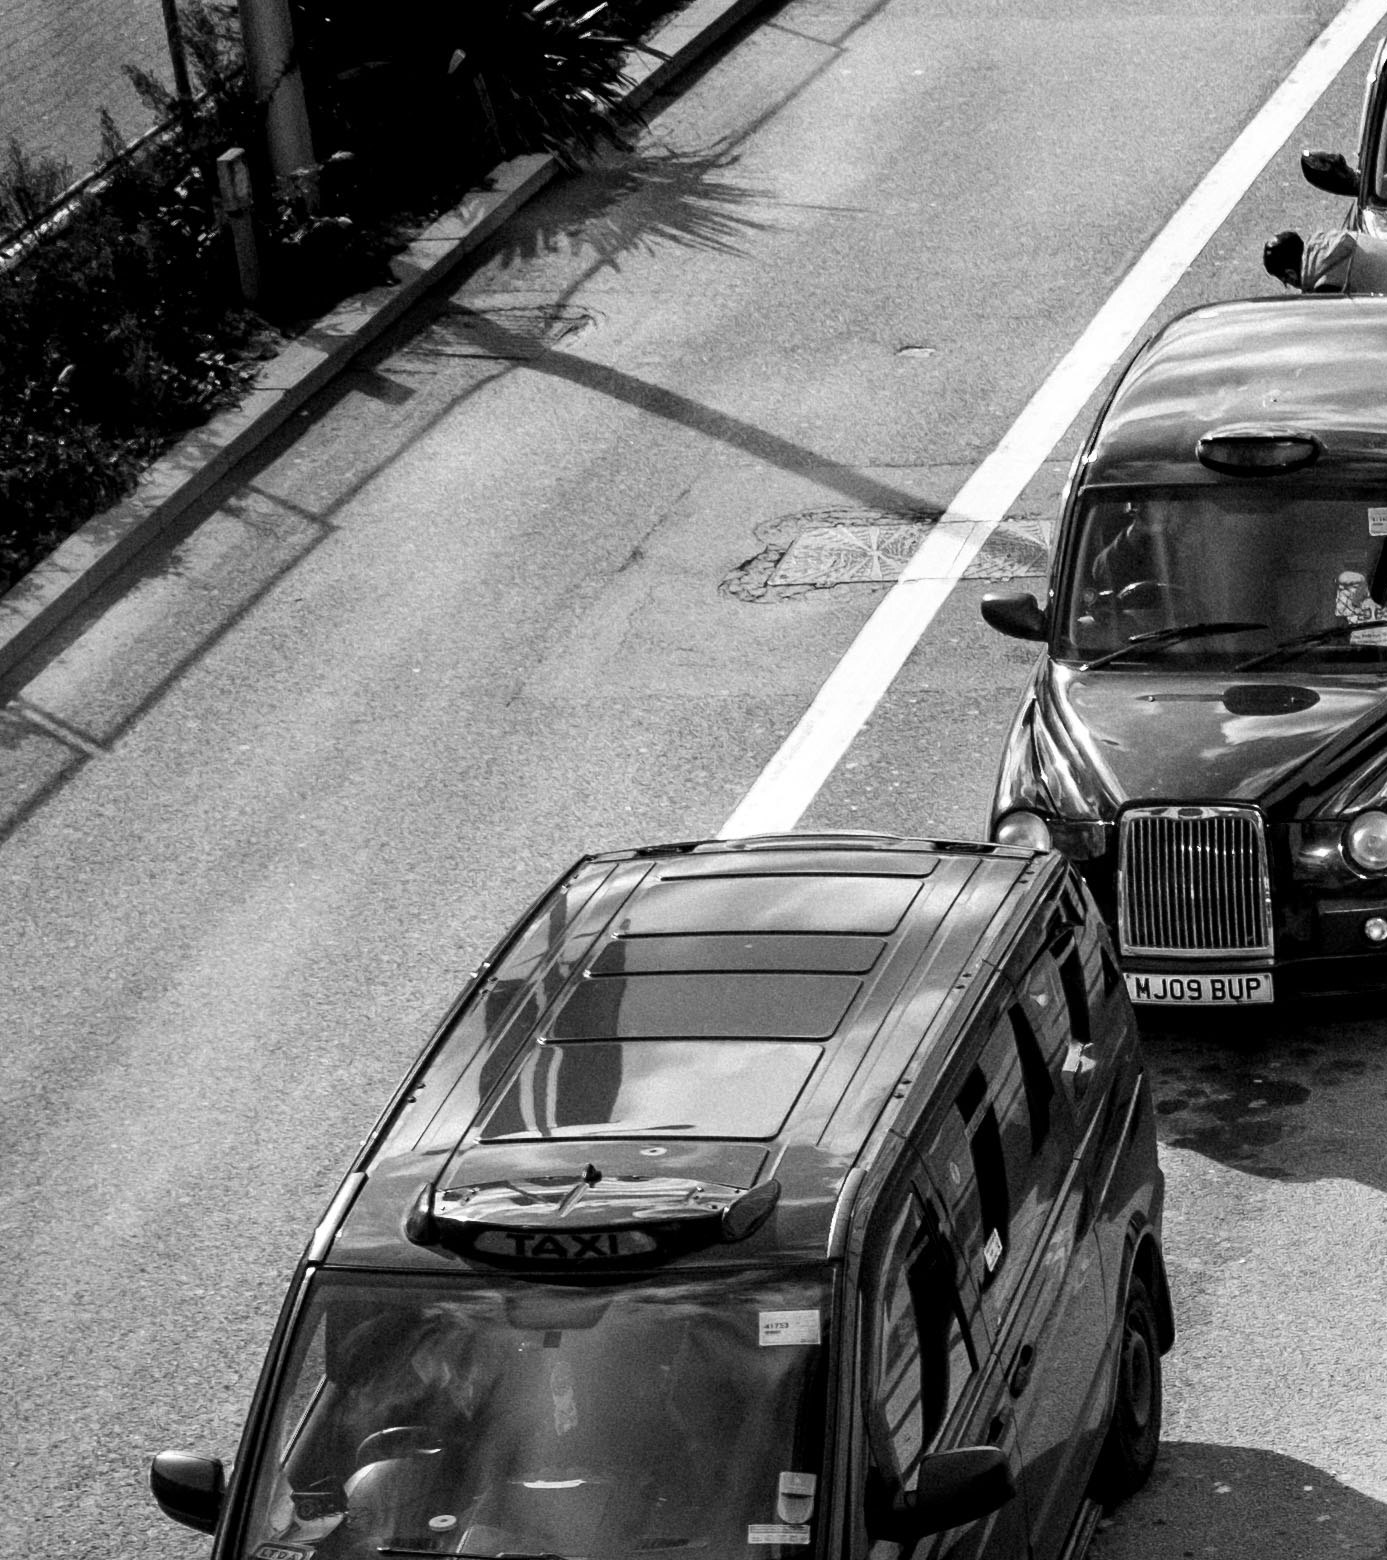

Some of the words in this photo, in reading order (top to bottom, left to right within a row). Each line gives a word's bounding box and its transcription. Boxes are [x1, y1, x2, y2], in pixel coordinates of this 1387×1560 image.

[1135, 976, 1203, 1001] MJ09
[1209, 976, 1262, 1002] BUP
[504, 1232, 620, 1258] TAXI
